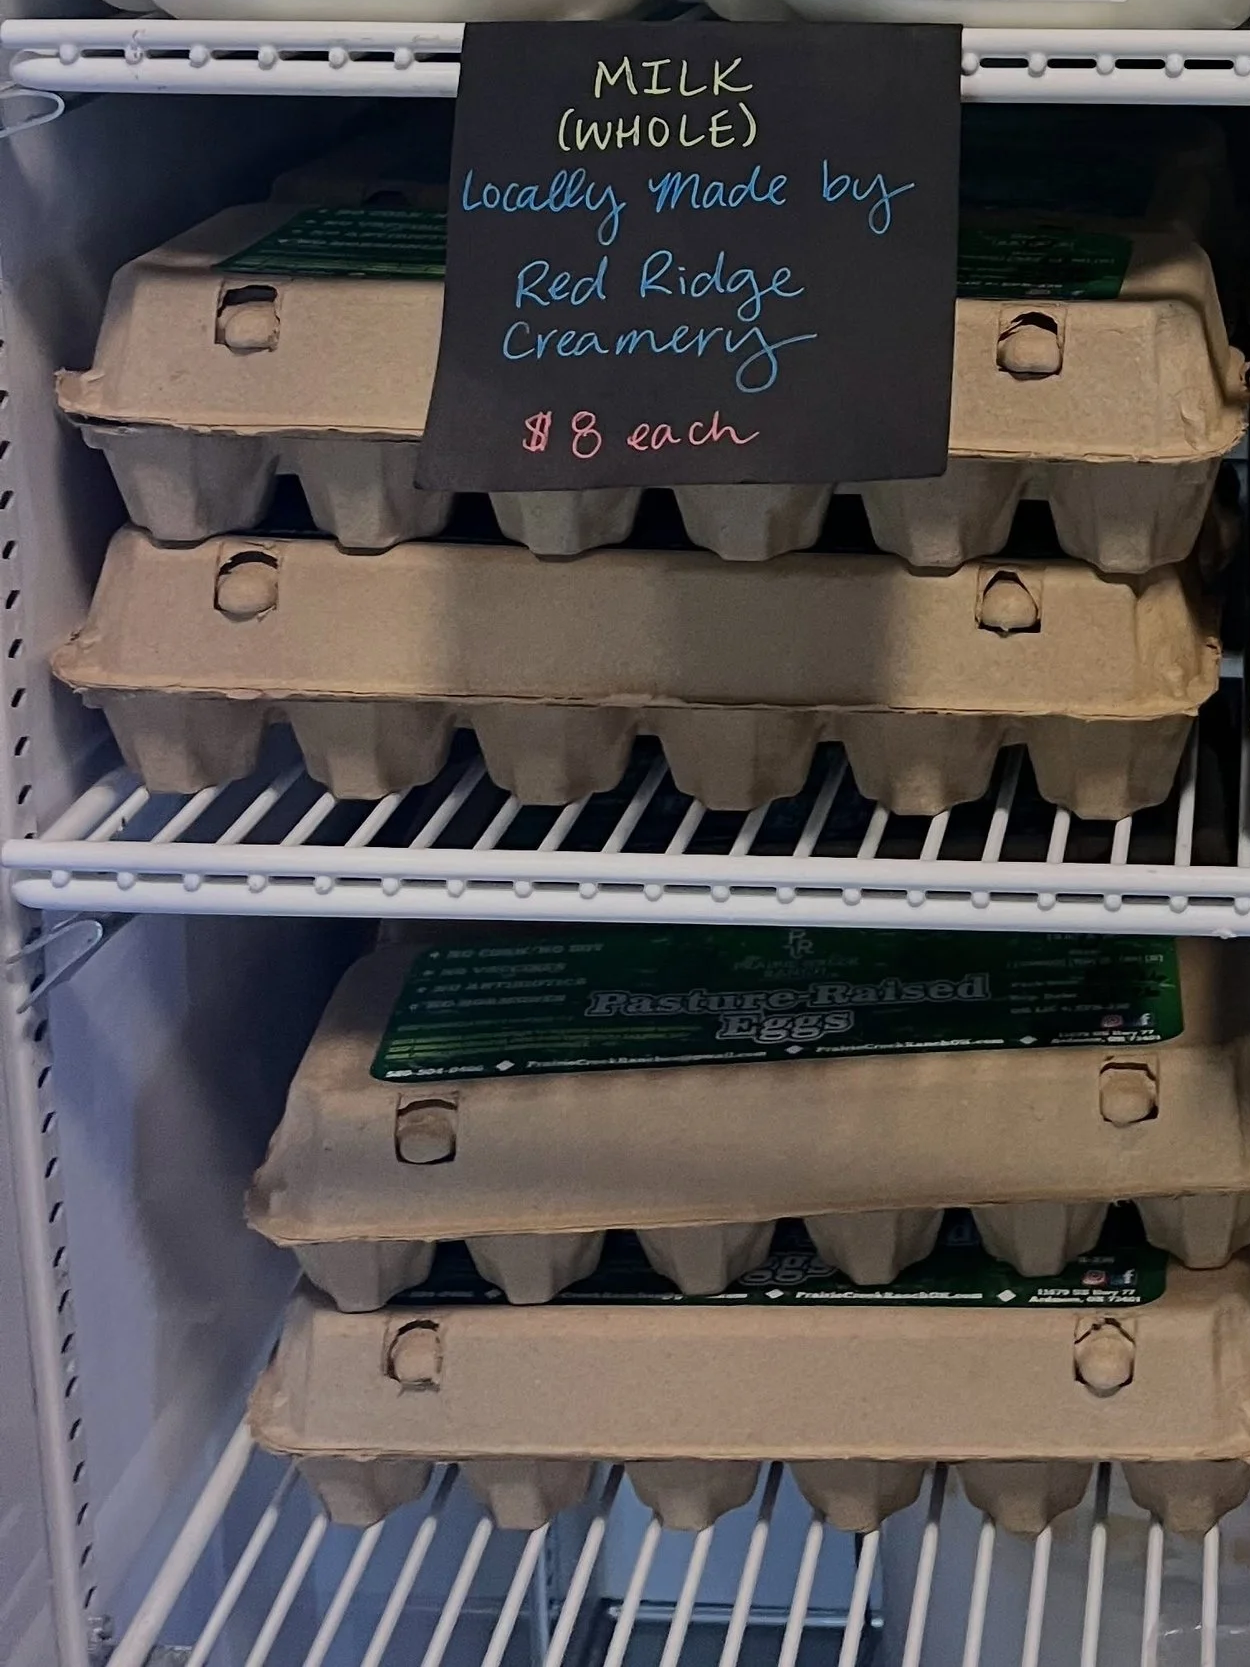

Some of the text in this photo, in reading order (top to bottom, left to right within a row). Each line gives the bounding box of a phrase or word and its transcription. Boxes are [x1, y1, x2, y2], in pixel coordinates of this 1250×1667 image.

[594, 57, 753, 98] MILK
[558, 103, 757, 152] (WHOLE)
[463, 169, 627, 245] Locally
[823, 160, 916, 234] by
[516, 250, 804, 321] Red Ridge
[503, 321, 818, 393] Creamery
[627, 411, 760, 451] each
[585, 972, 991, 1017] Pasture-Raised
[716, 1009, 854, 1043] Eggs
